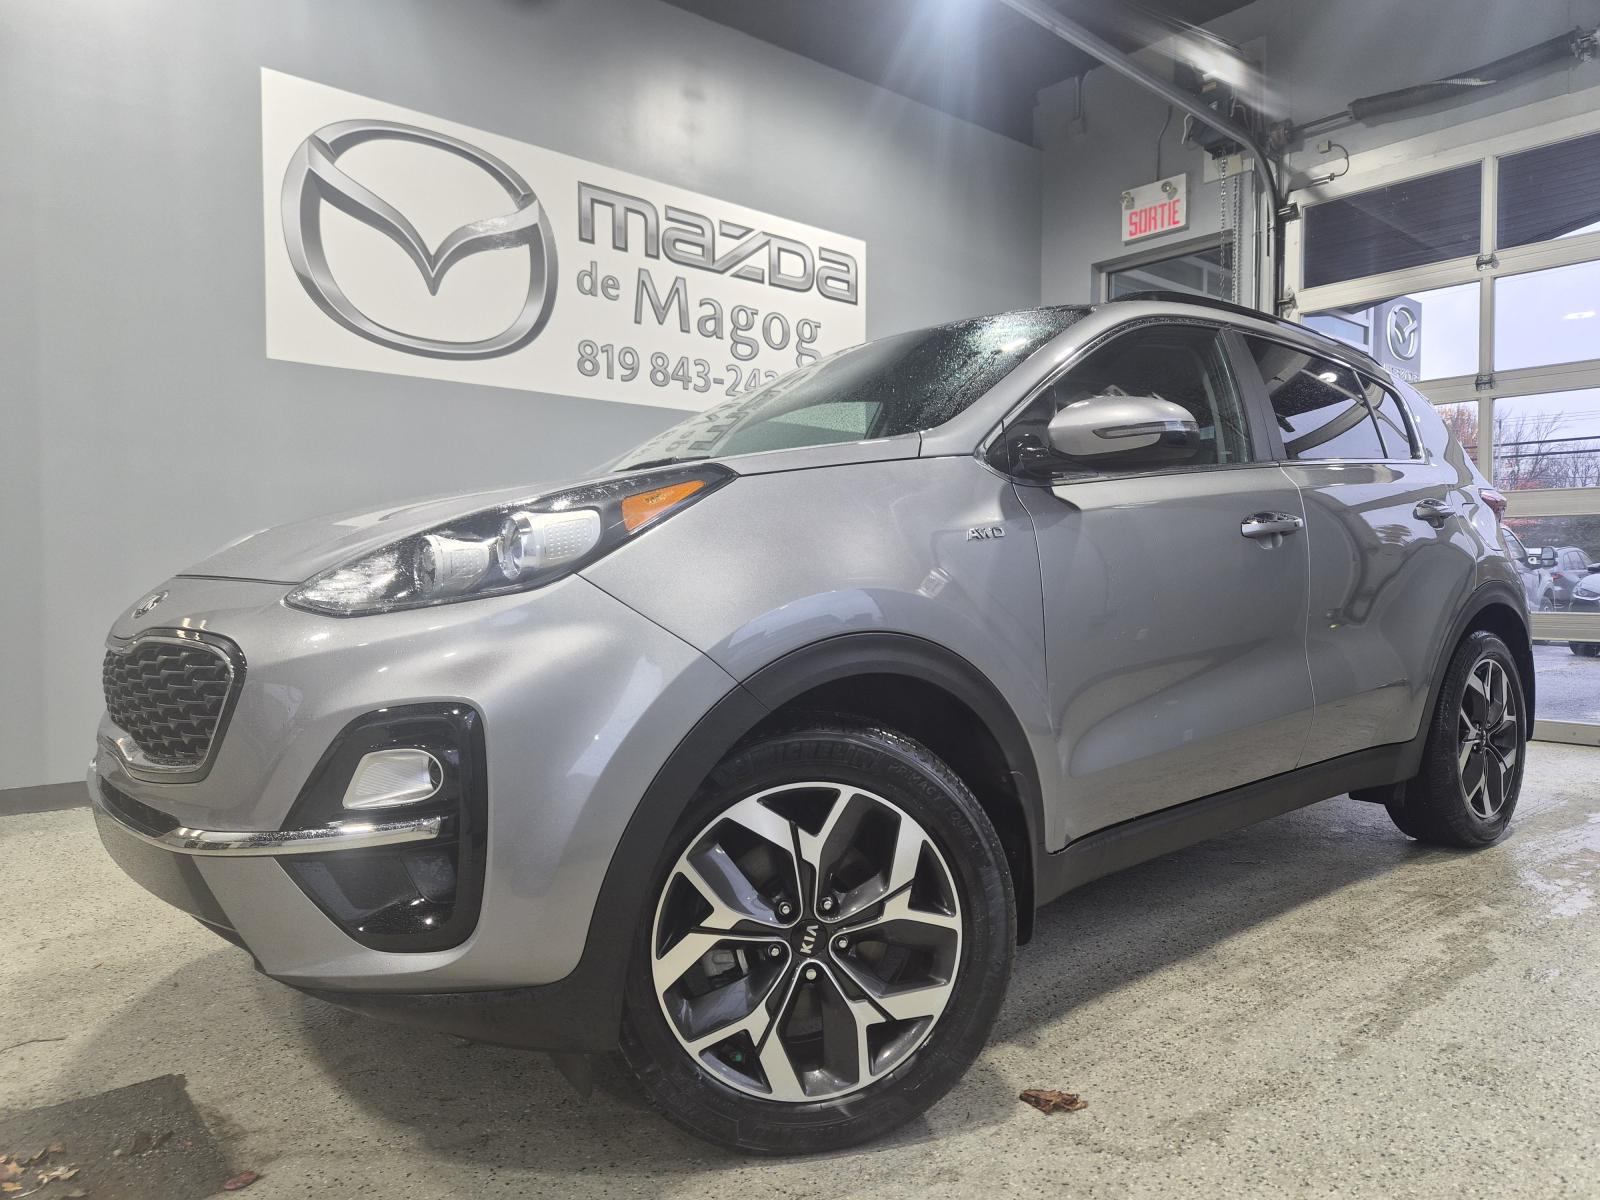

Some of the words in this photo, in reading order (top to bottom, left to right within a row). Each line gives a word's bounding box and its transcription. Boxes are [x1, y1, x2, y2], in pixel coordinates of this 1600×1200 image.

[1128, 198, 1181, 237] SORTIE
[576, 260, 621, 301] de
[633, 266, 822, 369] Magog
[576, 339, 640, 382] 819
[966, 526, 1006, 541] AWD
[800, 925, 819, 954] KIA
